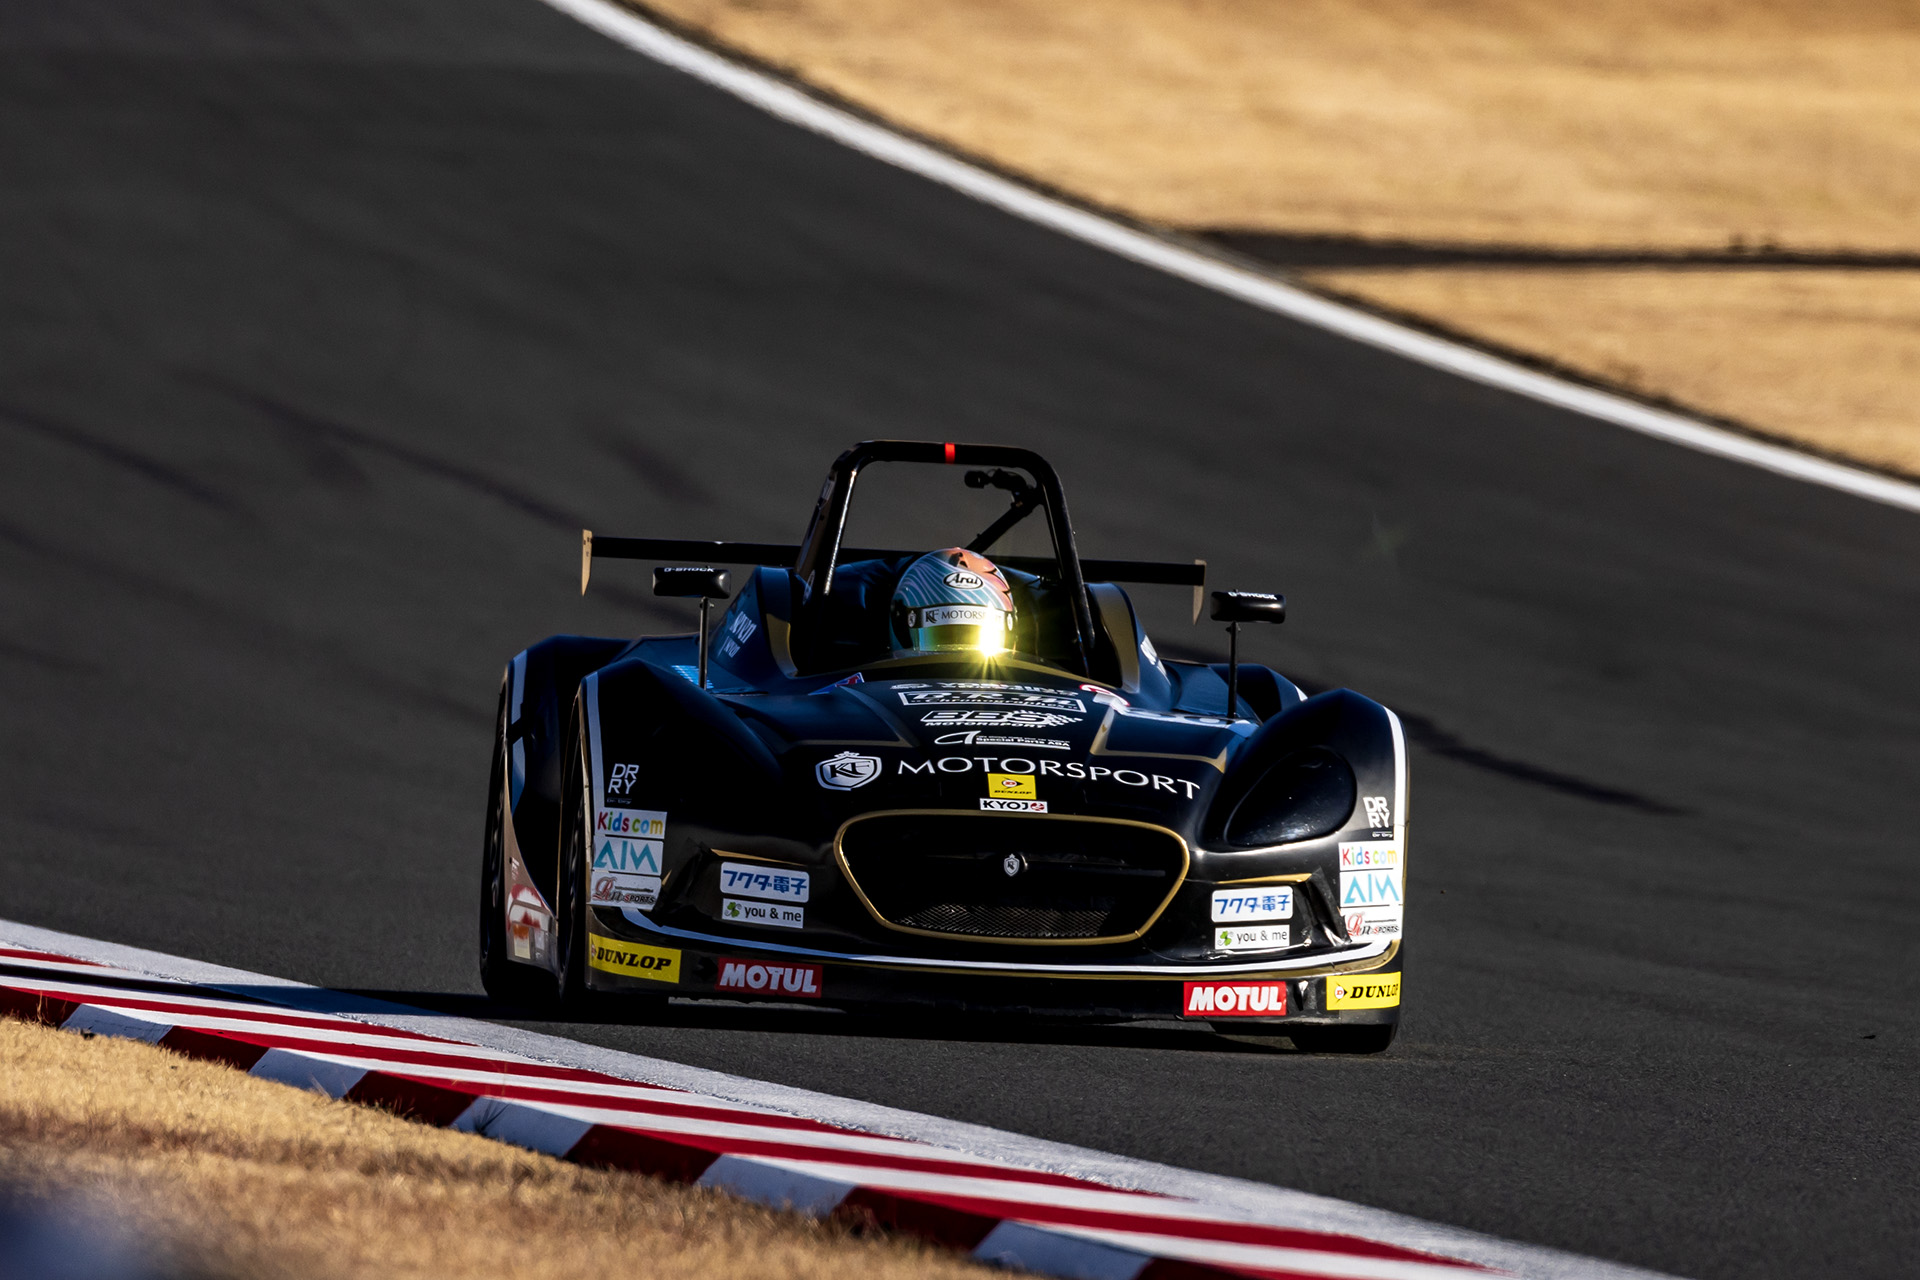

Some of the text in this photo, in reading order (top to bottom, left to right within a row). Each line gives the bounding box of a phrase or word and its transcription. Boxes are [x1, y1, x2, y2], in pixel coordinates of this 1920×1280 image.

[950, 573, 978, 584] Arai
[920, 710, 1050, 724] BBS
[898, 757, 1200, 799] MOTORSPORT
[593, 840, 659, 873] AIM
[723, 869, 807, 895] フクダ電子
[1344, 874, 1400, 904] AIM
[744, 904, 801, 921] you & me
[1214, 894, 1290, 914] フクダ電子
[1237, 930, 1287, 942] you & me
[597, 947, 672, 970] DUNLOP
[719, 963, 817, 993] MOTUL
[1188, 986, 1283, 1011] MOTUL
